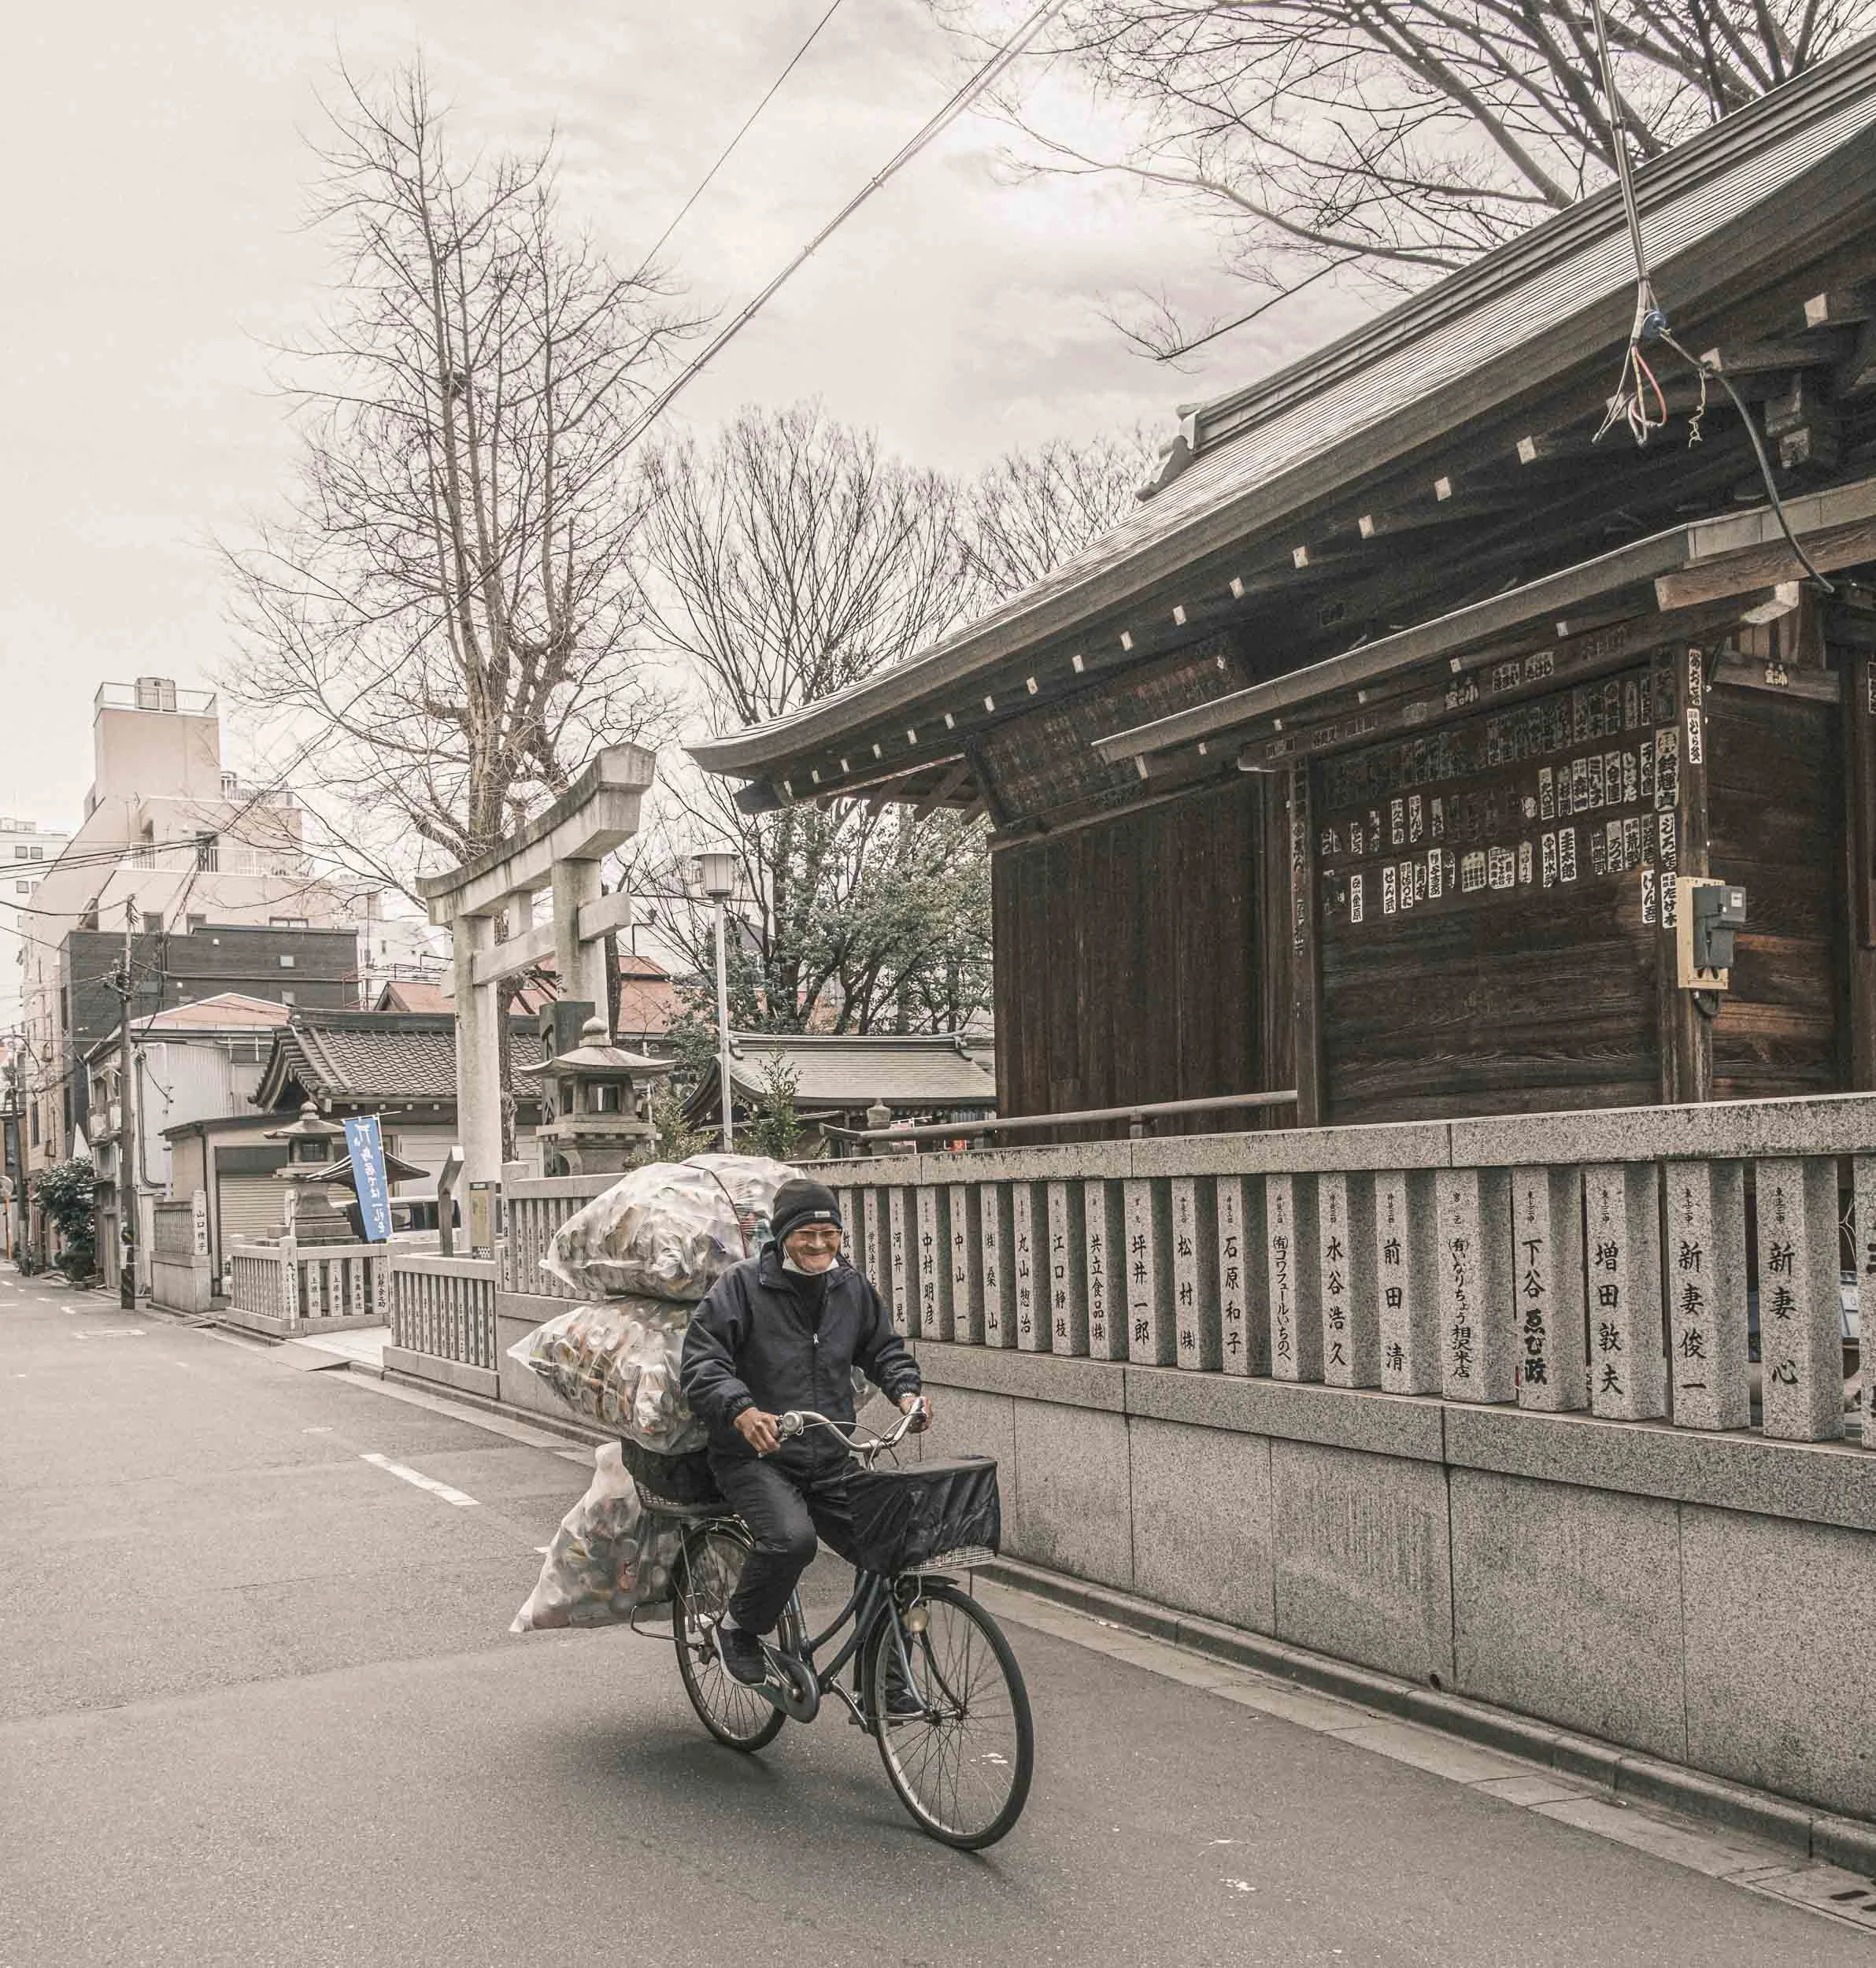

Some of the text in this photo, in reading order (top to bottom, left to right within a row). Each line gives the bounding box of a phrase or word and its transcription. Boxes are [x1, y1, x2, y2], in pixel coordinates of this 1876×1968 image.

[922, 1232, 934, 1325] 中村明彦
[954, 1233, 967, 1320] 中山一
[1019, 1233, 1031, 1336] 丸山惣治
[1053, 1234, 1067, 1337] 江口静枝
[1132, 1234, 1150, 1346] 坪井一郎
[1223, 1236, 1241, 1355] 石原和子
[1326, 1236, 1348, 1365] 水谷浩久
[1383, 1237, 1405, 1372] 前田清
[1595, 1240, 1623, 1395] 増田敦夫
[1678, 1241, 1707, 1389] 新妻俊一
[1770, 1241, 1800, 1385] 新妻心
